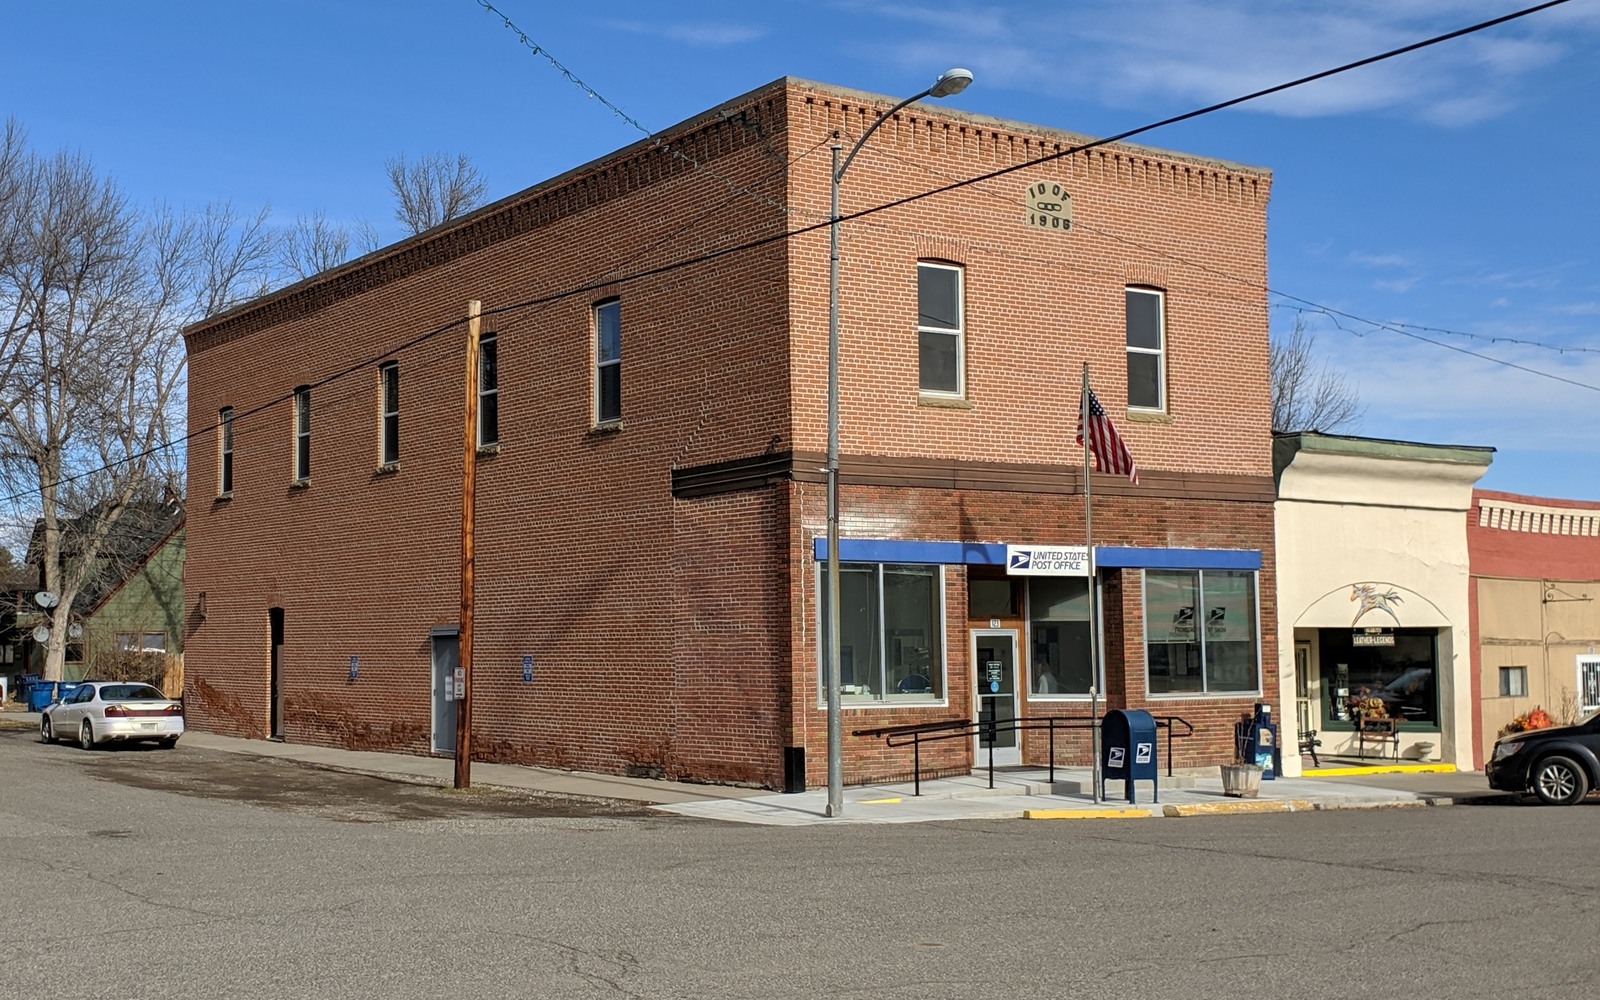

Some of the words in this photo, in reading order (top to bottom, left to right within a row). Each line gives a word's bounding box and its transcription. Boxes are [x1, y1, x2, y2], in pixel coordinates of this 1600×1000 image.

[1030, 213, 1070, 230] 1906
[1033, 551, 1063, 561] UNITED
[1031, 560, 1052, 570] POST
[1053, 561, 1081, 570] OFFICE
